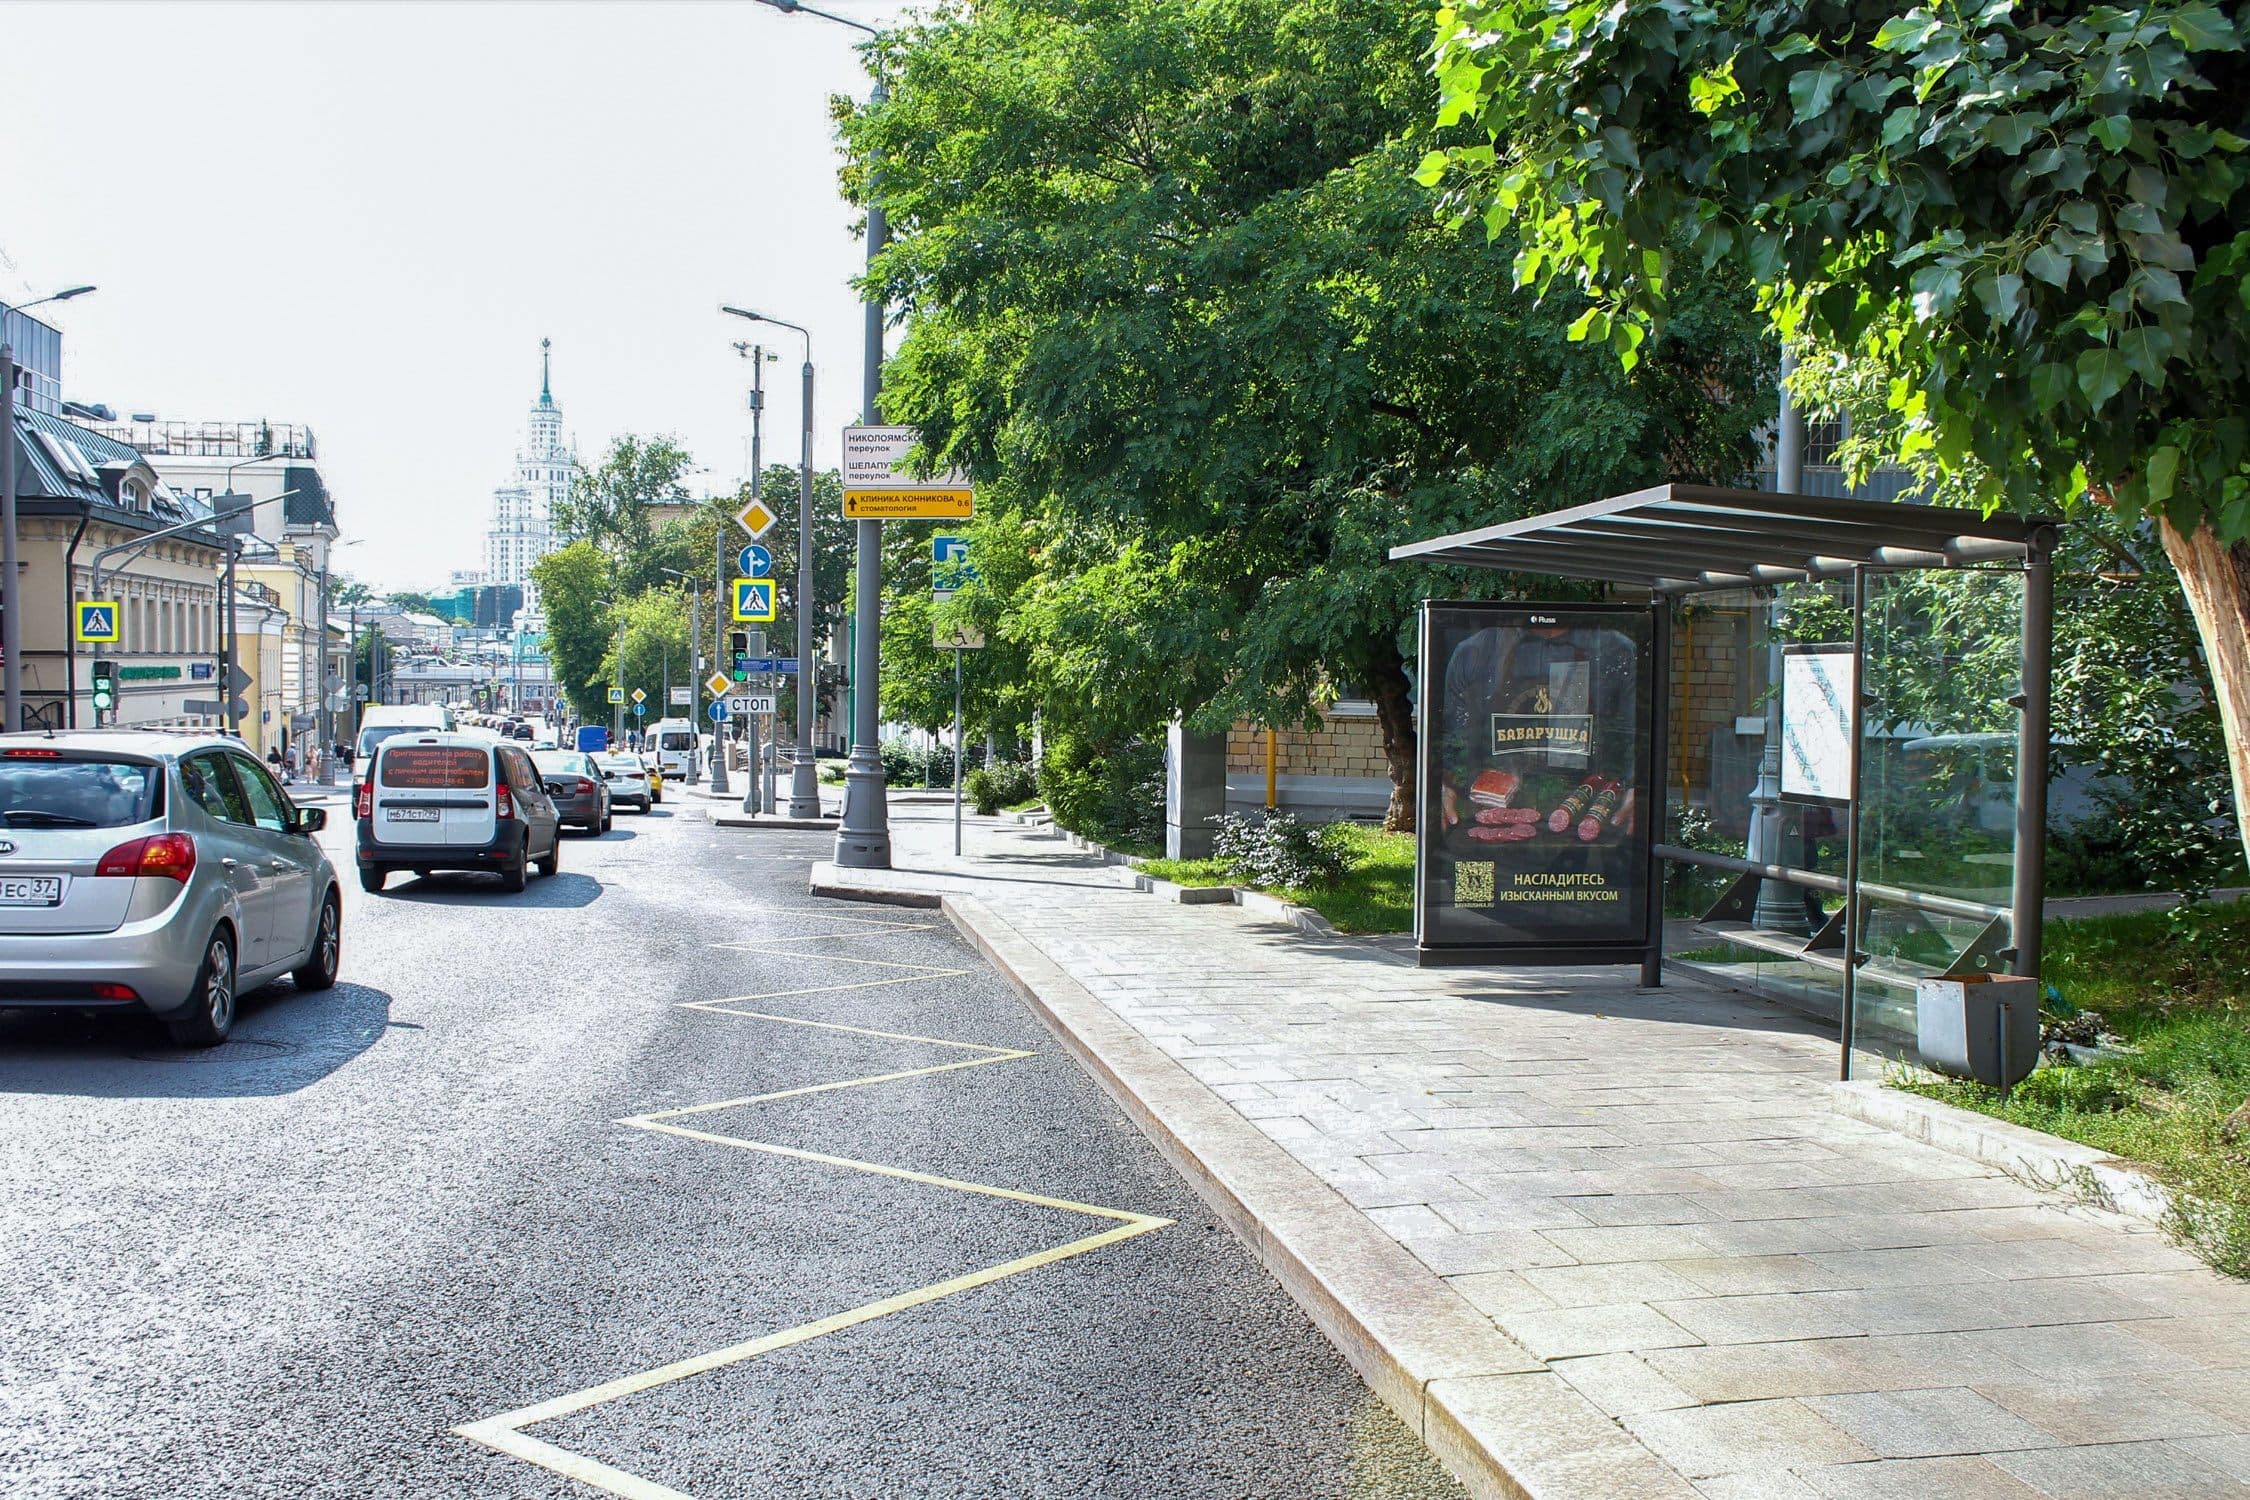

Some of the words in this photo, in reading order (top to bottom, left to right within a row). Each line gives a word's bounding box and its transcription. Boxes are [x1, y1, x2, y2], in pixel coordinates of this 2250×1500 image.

[848, 445, 891, 453] переулок
[860, 495, 900, 503] КЛИНИКА
[902, 495, 955, 503] КОННИКОВА
[732, 699, 769, 711] СТОП
[1496, 727, 1588, 743] БАВАРУШКА
[389, 750, 440, 758] Приглашаем
[454, 750, 483, 760] работу
[1514, 873, 1605, 887] НАСЛАДИТЕСЬ
[1500, 890, 1574, 901] ИЗЫСКАННЫМ
[1577, 890, 1618, 901] ВКУСОМ
